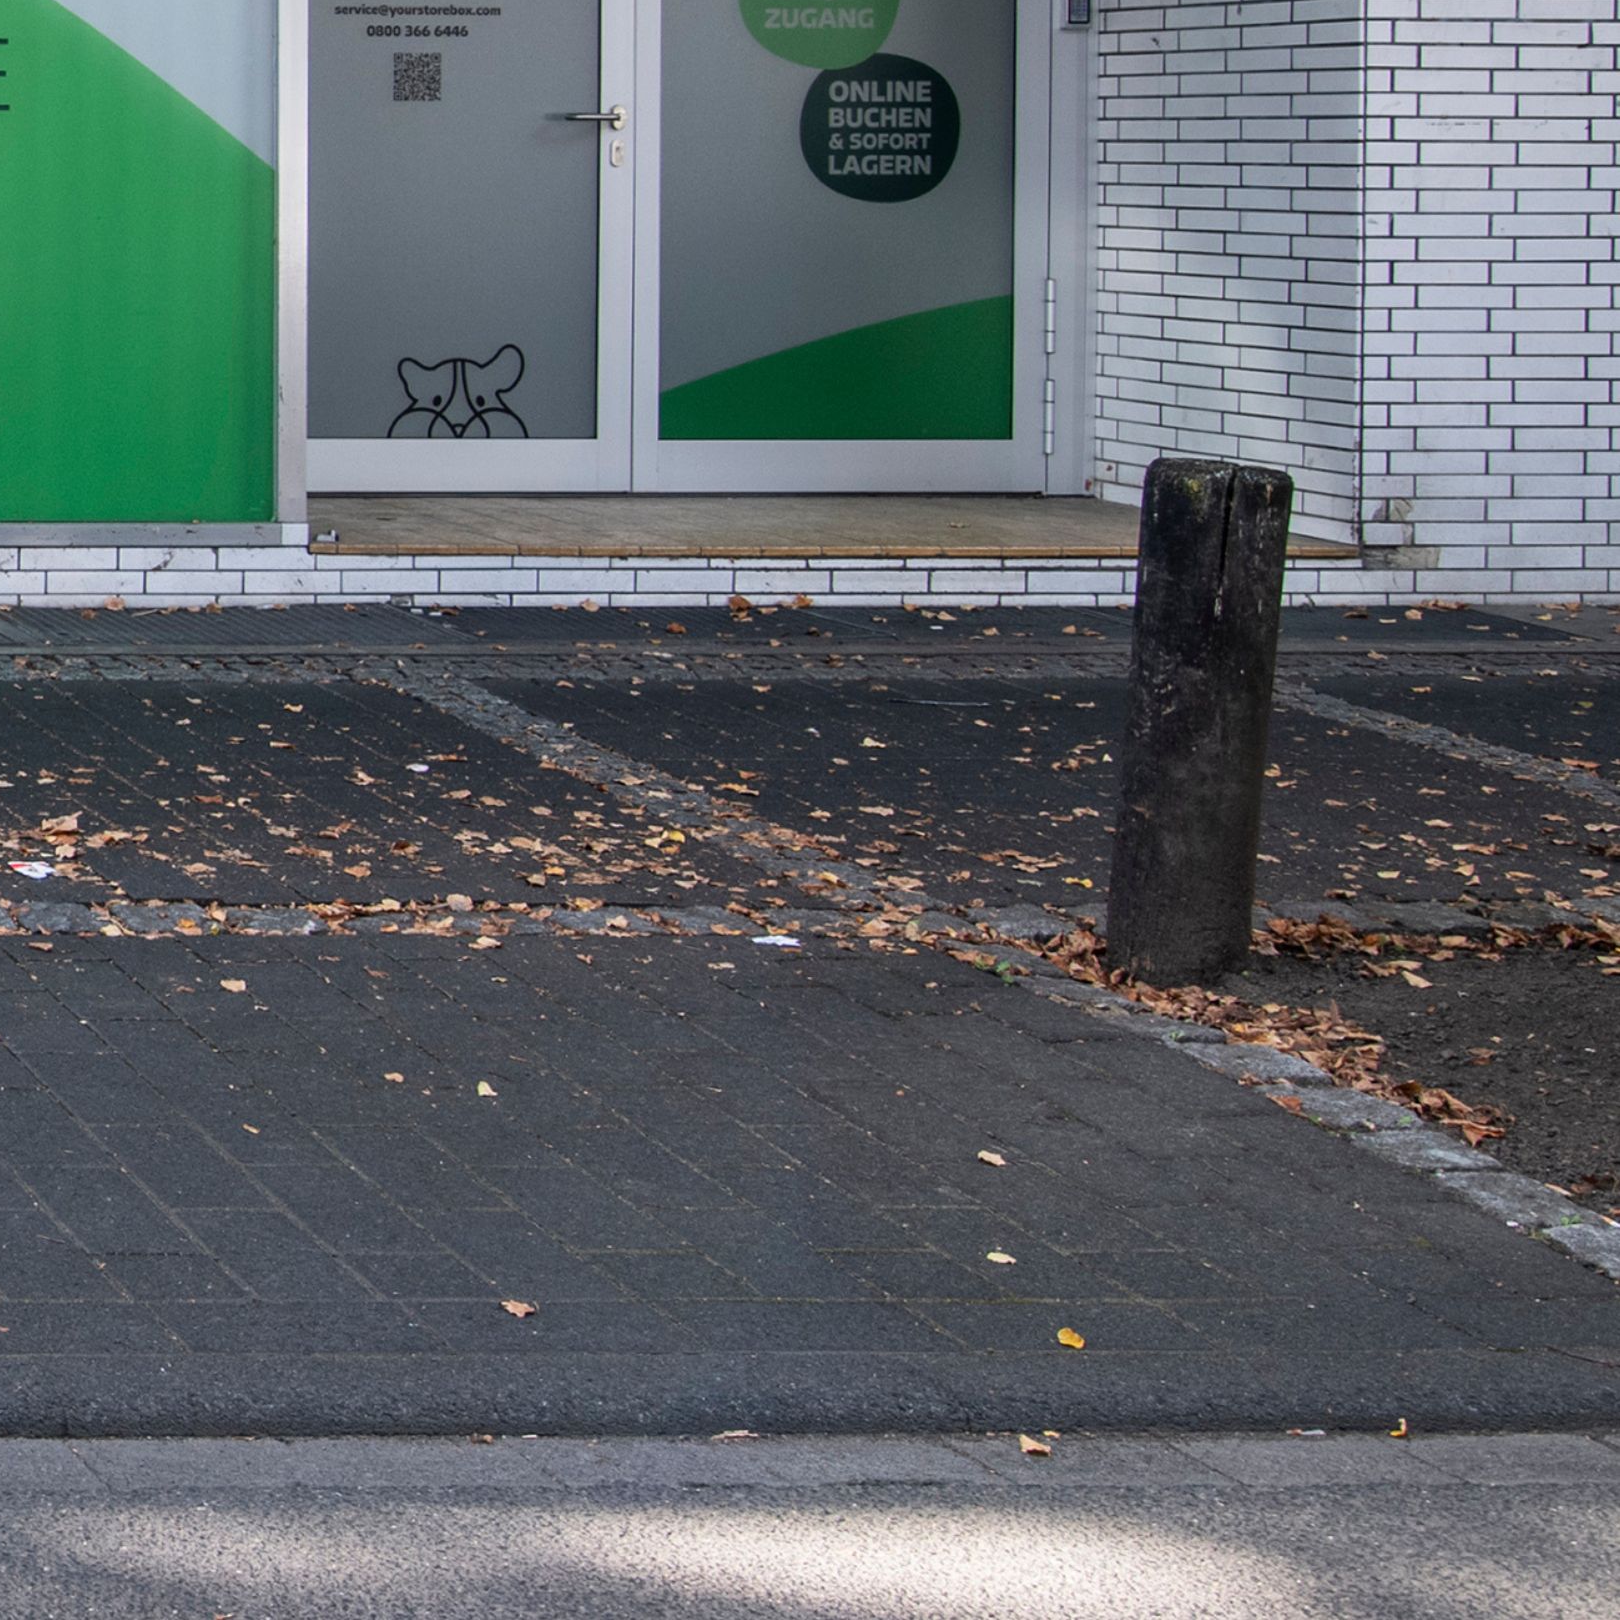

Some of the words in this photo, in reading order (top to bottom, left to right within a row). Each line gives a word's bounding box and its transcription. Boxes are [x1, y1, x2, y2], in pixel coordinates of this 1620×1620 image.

[334, 4, 501, 18] service@yourstorebox.com
[764, 8, 875, 29] ZUGANG
[366, 25, 401, 37] 0800
[405, 25, 431, 37] 366
[434, 25, 469, 37] 6446
[828, 80, 932, 103] ONLINE
[828, 107, 932, 128] BUCHEN
[828, 133, 844, 150] &
[849, 133, 932, 150] SOFORT
[828, 154, 932, 175] LAGERN
